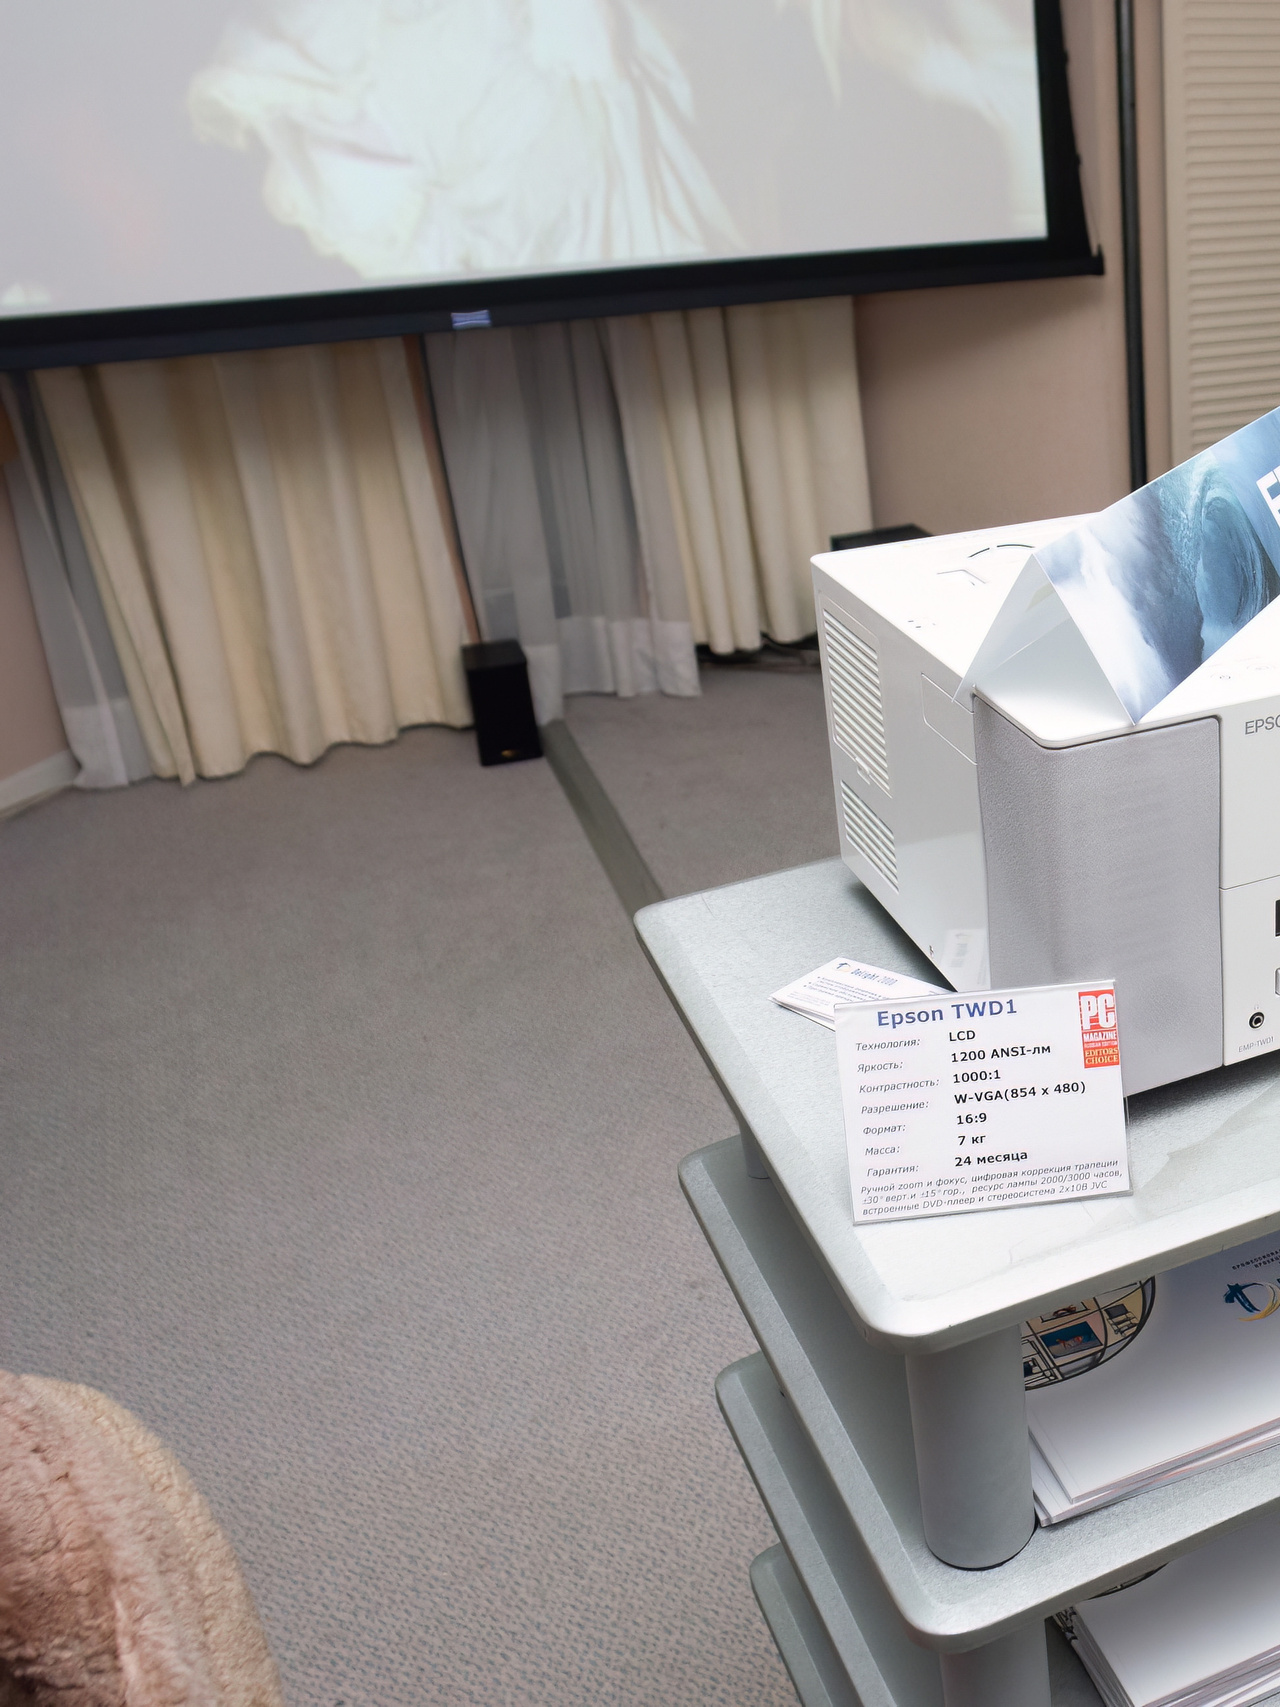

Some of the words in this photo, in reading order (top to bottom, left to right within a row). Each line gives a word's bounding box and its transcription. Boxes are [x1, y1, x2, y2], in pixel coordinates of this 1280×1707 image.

[877, 1009, 944, 1029] Epson
[951, 999, 1018, 1020] TWD1
[1080, 993, 1116, 1030] PC
[949, 1030, 976, 1042] LCD
[1083, 1031, 1117, 1043] MAGAZINE
[856, 1037, 921, 1051] Технология:
[1238, 1036, 1274, 1053] EMP-TWD1
[951, 1050, 986, 1063] 1200
[991, 1044, 1051, 1059] ANSI-лм
[1085, 1054, 1119, 1065] CHOICE
[857, 1061, 904, 1073] Яркость:
[953, 1069, 1001, 1084] 1000:1
[859, 1078, 940, 1094] Контрастность:
[954, 1086, 1037, 1105] W-VGA(854
[1053, 1081, 1086, 1095] 480)
[861, 1100, 930, 1115] Разрешение:
[956, 1112, 987, 1126] 16:9
[863, 1123, 906, 1137] Формат:
[958, 1135, 967, 1146] 7
[971, 1134, 986, 1147] кг
[865, 1145, 900, 1157] Масса:
[955, 1155, 972, 1167] 24
[976, 1151, 1028, 1165] месяца
[861, 1183, 895, 1195] Ручной
[898, 1181, 923, 1190] zoom
[935, 1176, 967, 1189] фокус,
[971, 1170, 1018, 1183] цифровая
[1021, 1165, 1072, 1177] коррекция
[1074, 1160, 1118, 1172] трапеции
[867, 1164, 919, 1178] Гарантия:
[971, 1182, 1004, 1194] ресурс
[1006, 1179, 1038, 1189] лампы
[1040, 1171, 1091, 1185] 2000/3000
[1093, 1169, 1123, 1180] часов,
[862, 1203, 920, 1216] встроенные
[987, 1187, 1056, 1202] стереосистема
[1090, 1180, 1108, 1191] JVC
